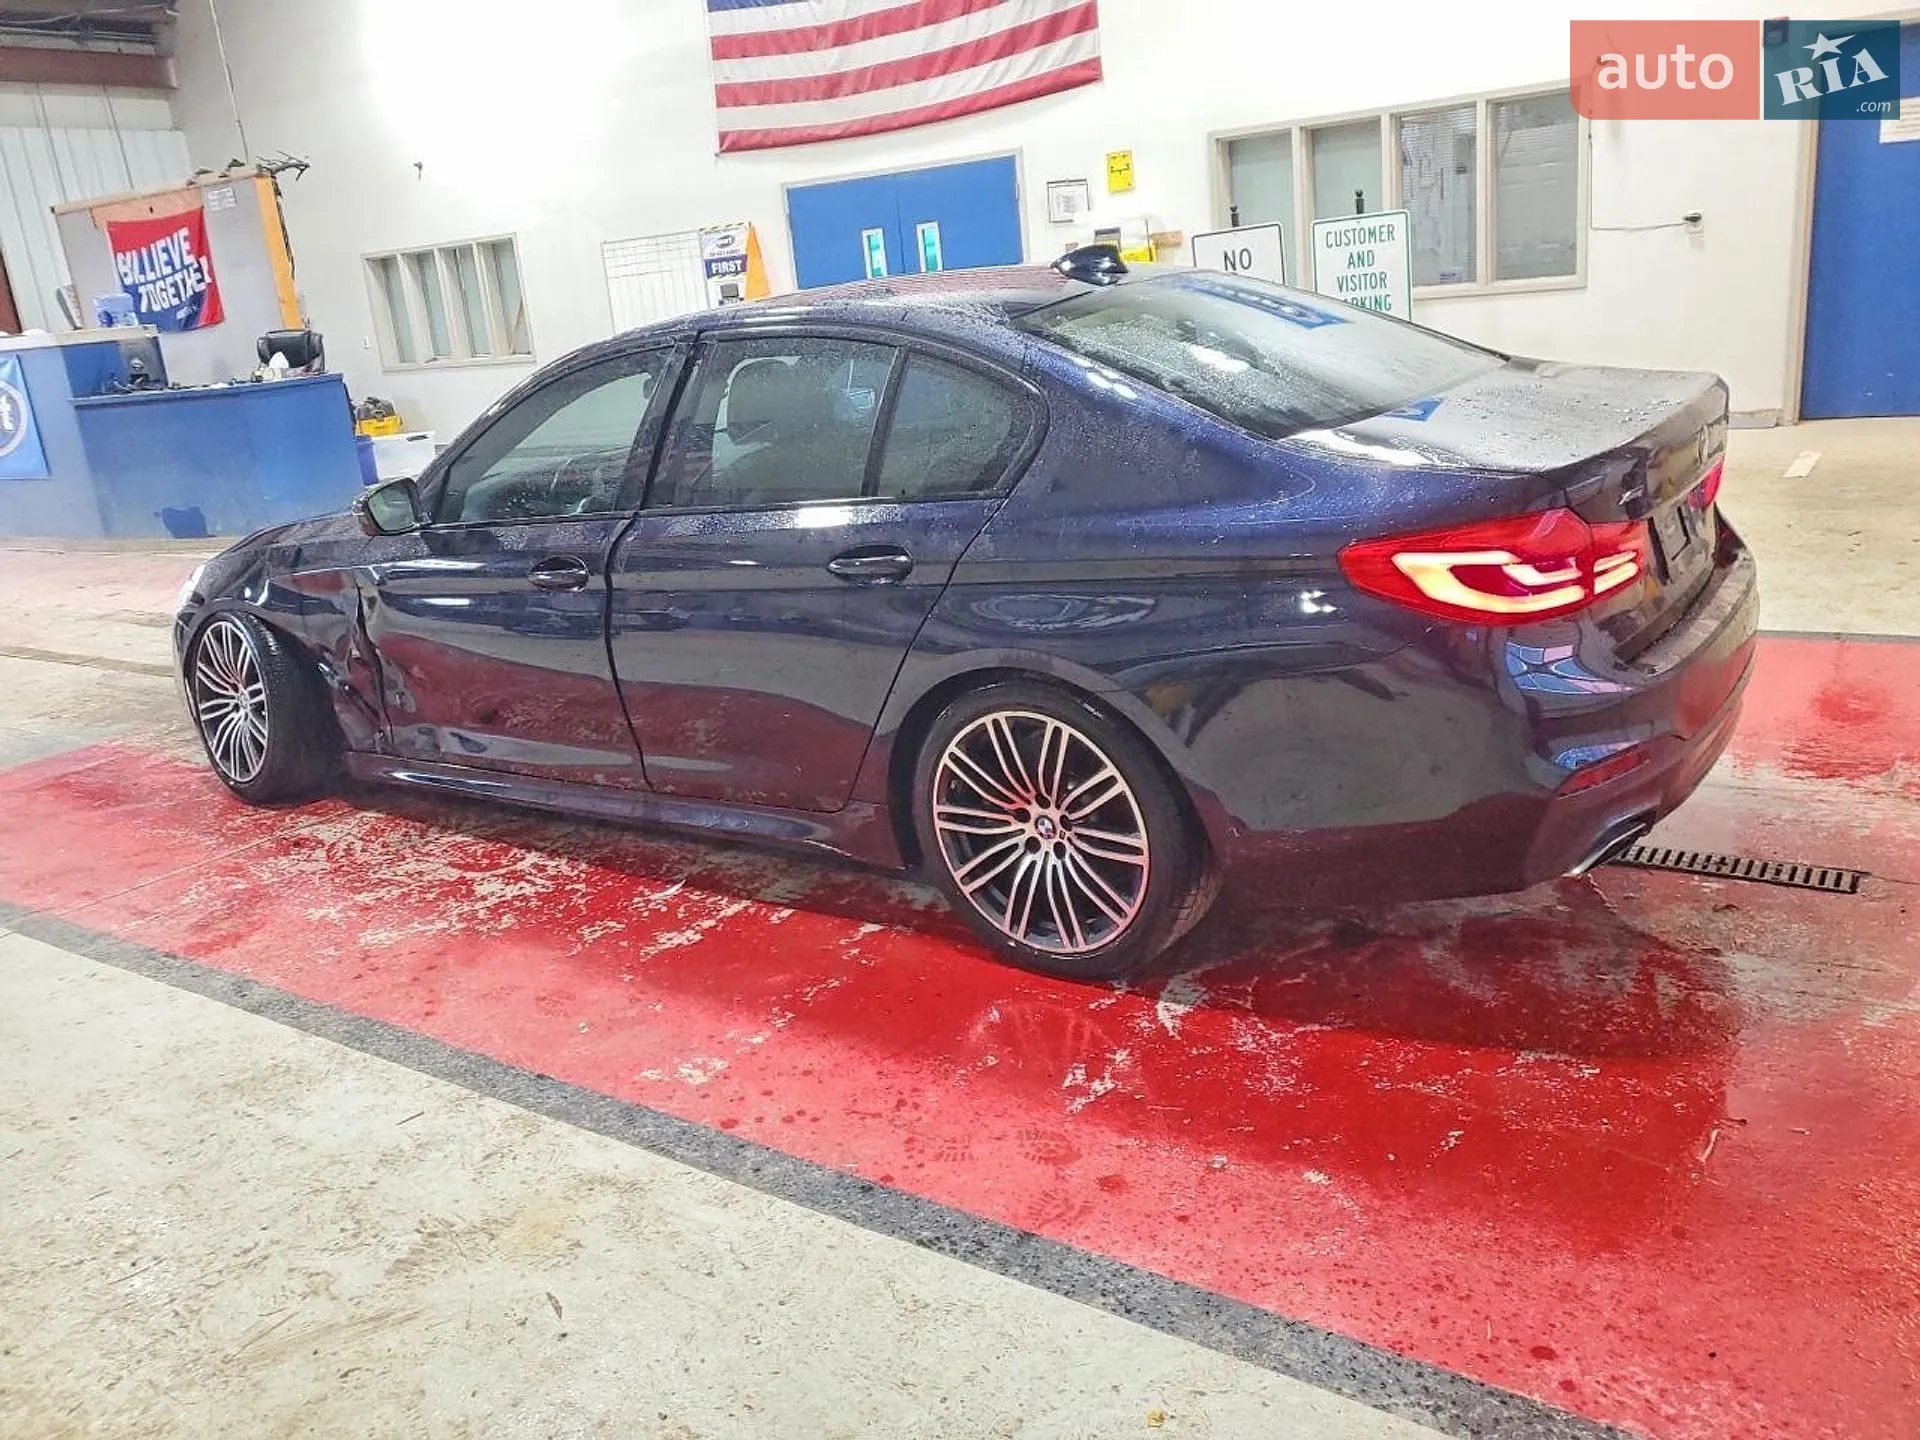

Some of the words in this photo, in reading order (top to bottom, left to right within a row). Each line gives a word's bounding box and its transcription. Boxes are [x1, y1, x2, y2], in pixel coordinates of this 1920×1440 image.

[1325, 224, 1395, 248] CUSTOMER
[711, 260, 743, 275] FIRST
[1224, 247, 1252, 271] NO
[1347, 250, 1375, 269] AND
[1336, 271, 1388, 293] VISITOR
[1343, 294, 1392, 311] RKING
